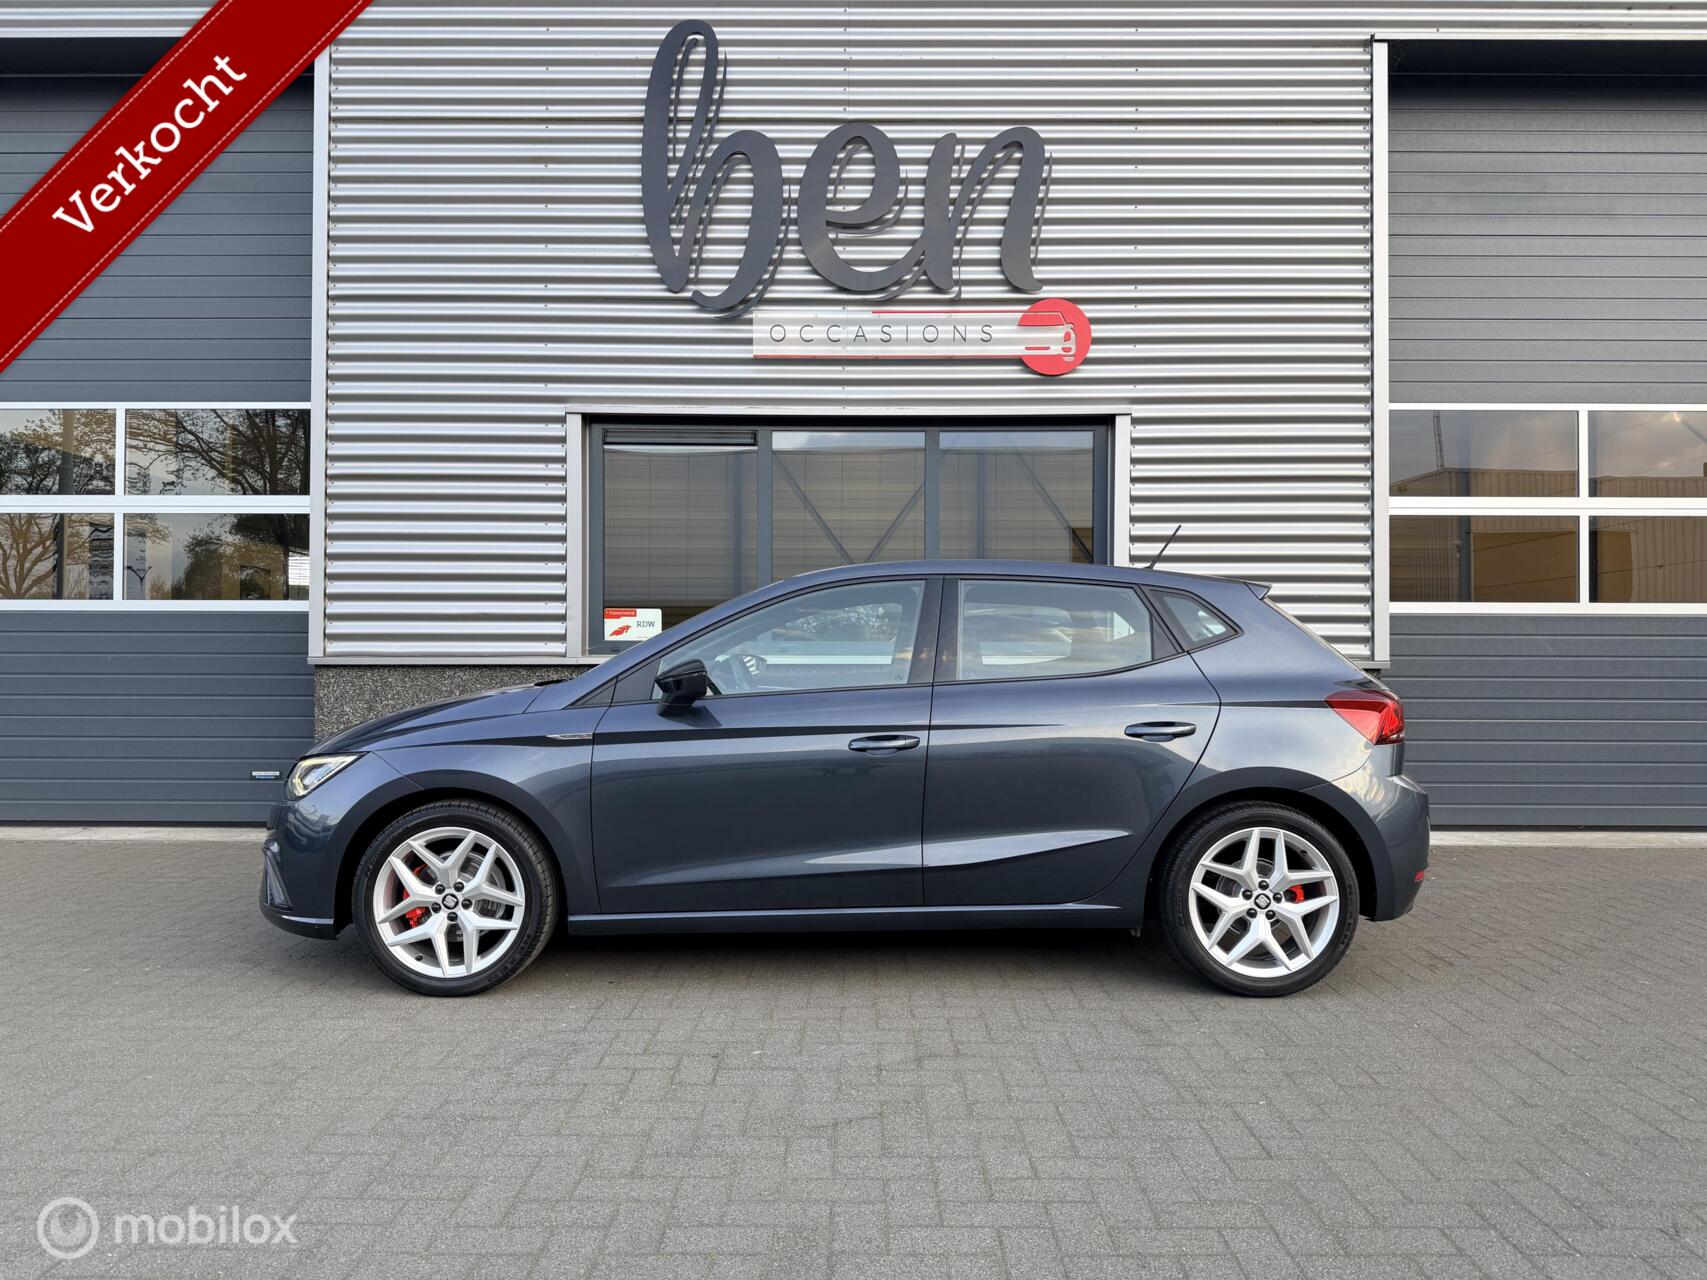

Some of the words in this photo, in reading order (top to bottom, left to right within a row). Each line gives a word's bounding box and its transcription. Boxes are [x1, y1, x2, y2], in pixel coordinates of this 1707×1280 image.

[640, 18, 1046, 311] ben
[769, 323, 993, 343] OCCASIONS
[636, 620, 656, 628] RDW
